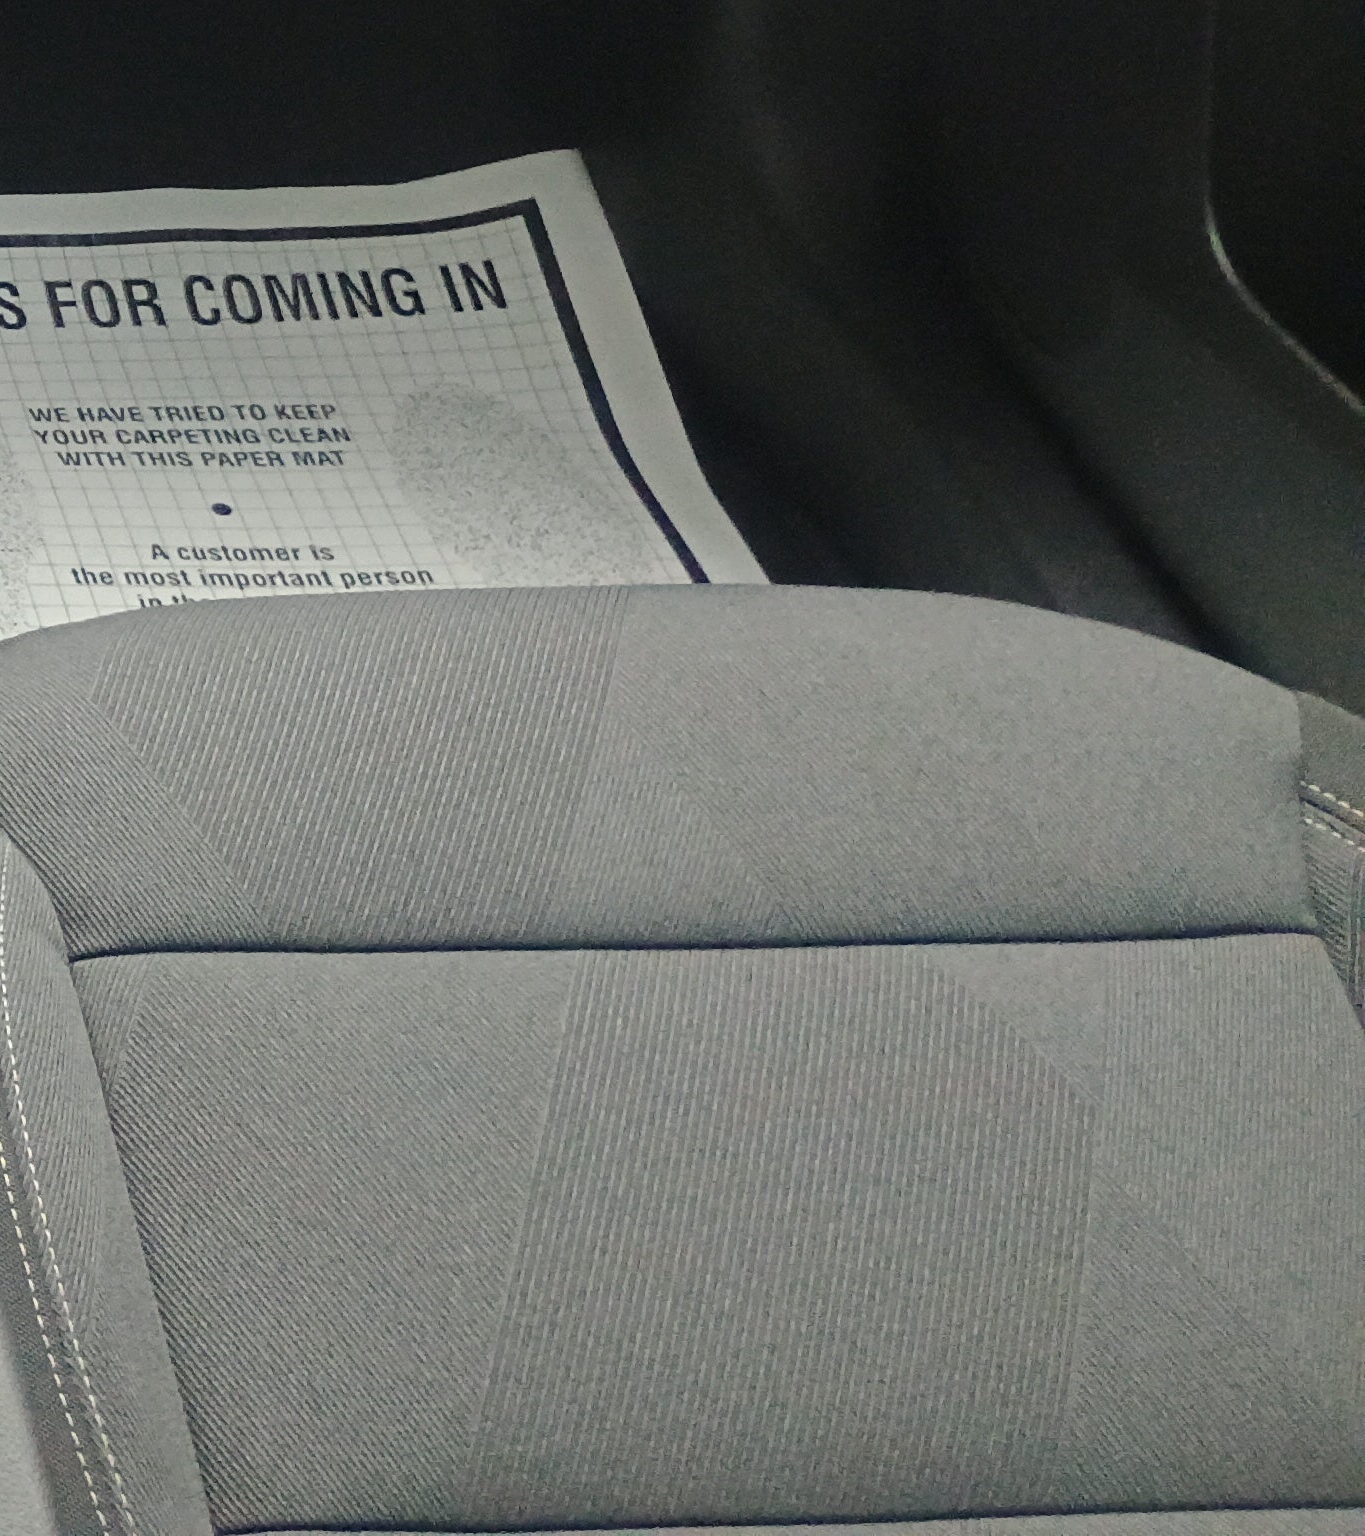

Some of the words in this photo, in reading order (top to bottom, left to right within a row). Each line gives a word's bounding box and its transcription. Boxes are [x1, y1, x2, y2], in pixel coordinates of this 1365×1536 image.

[43, 278, 167, 329] FOR
[183, 267, 426, 326] COMING
[438, 259, 508, 312] IN
[28, 407, 70, 423] WE
[76, 406, 144, 423] HAVE
[148, 405, 225, 422] TRIED
[230, 404, 267, 421] TO
[274, 404, 336, 420] KEEP
[34, 429, 108, 445] YOUR
[115, 428, 261, 445] CARPETING
[267, 427, 351, 443] CLEAN
[57, 451, 125, 467] WITH
[130, 450, 194, 467] THIS
[201, 450, 284, 467] PAPER
[292, 449, 346, 466] MAT
[151, 544, 169, 560] A
[177, 545, 302, 562] customer
[309, 544, 335, 561] is
[70, 567, 114, 586] the
[124, 567, 192, 586] most
[198, 568, 333, 590] important
[339, 568, 434, 590] person
